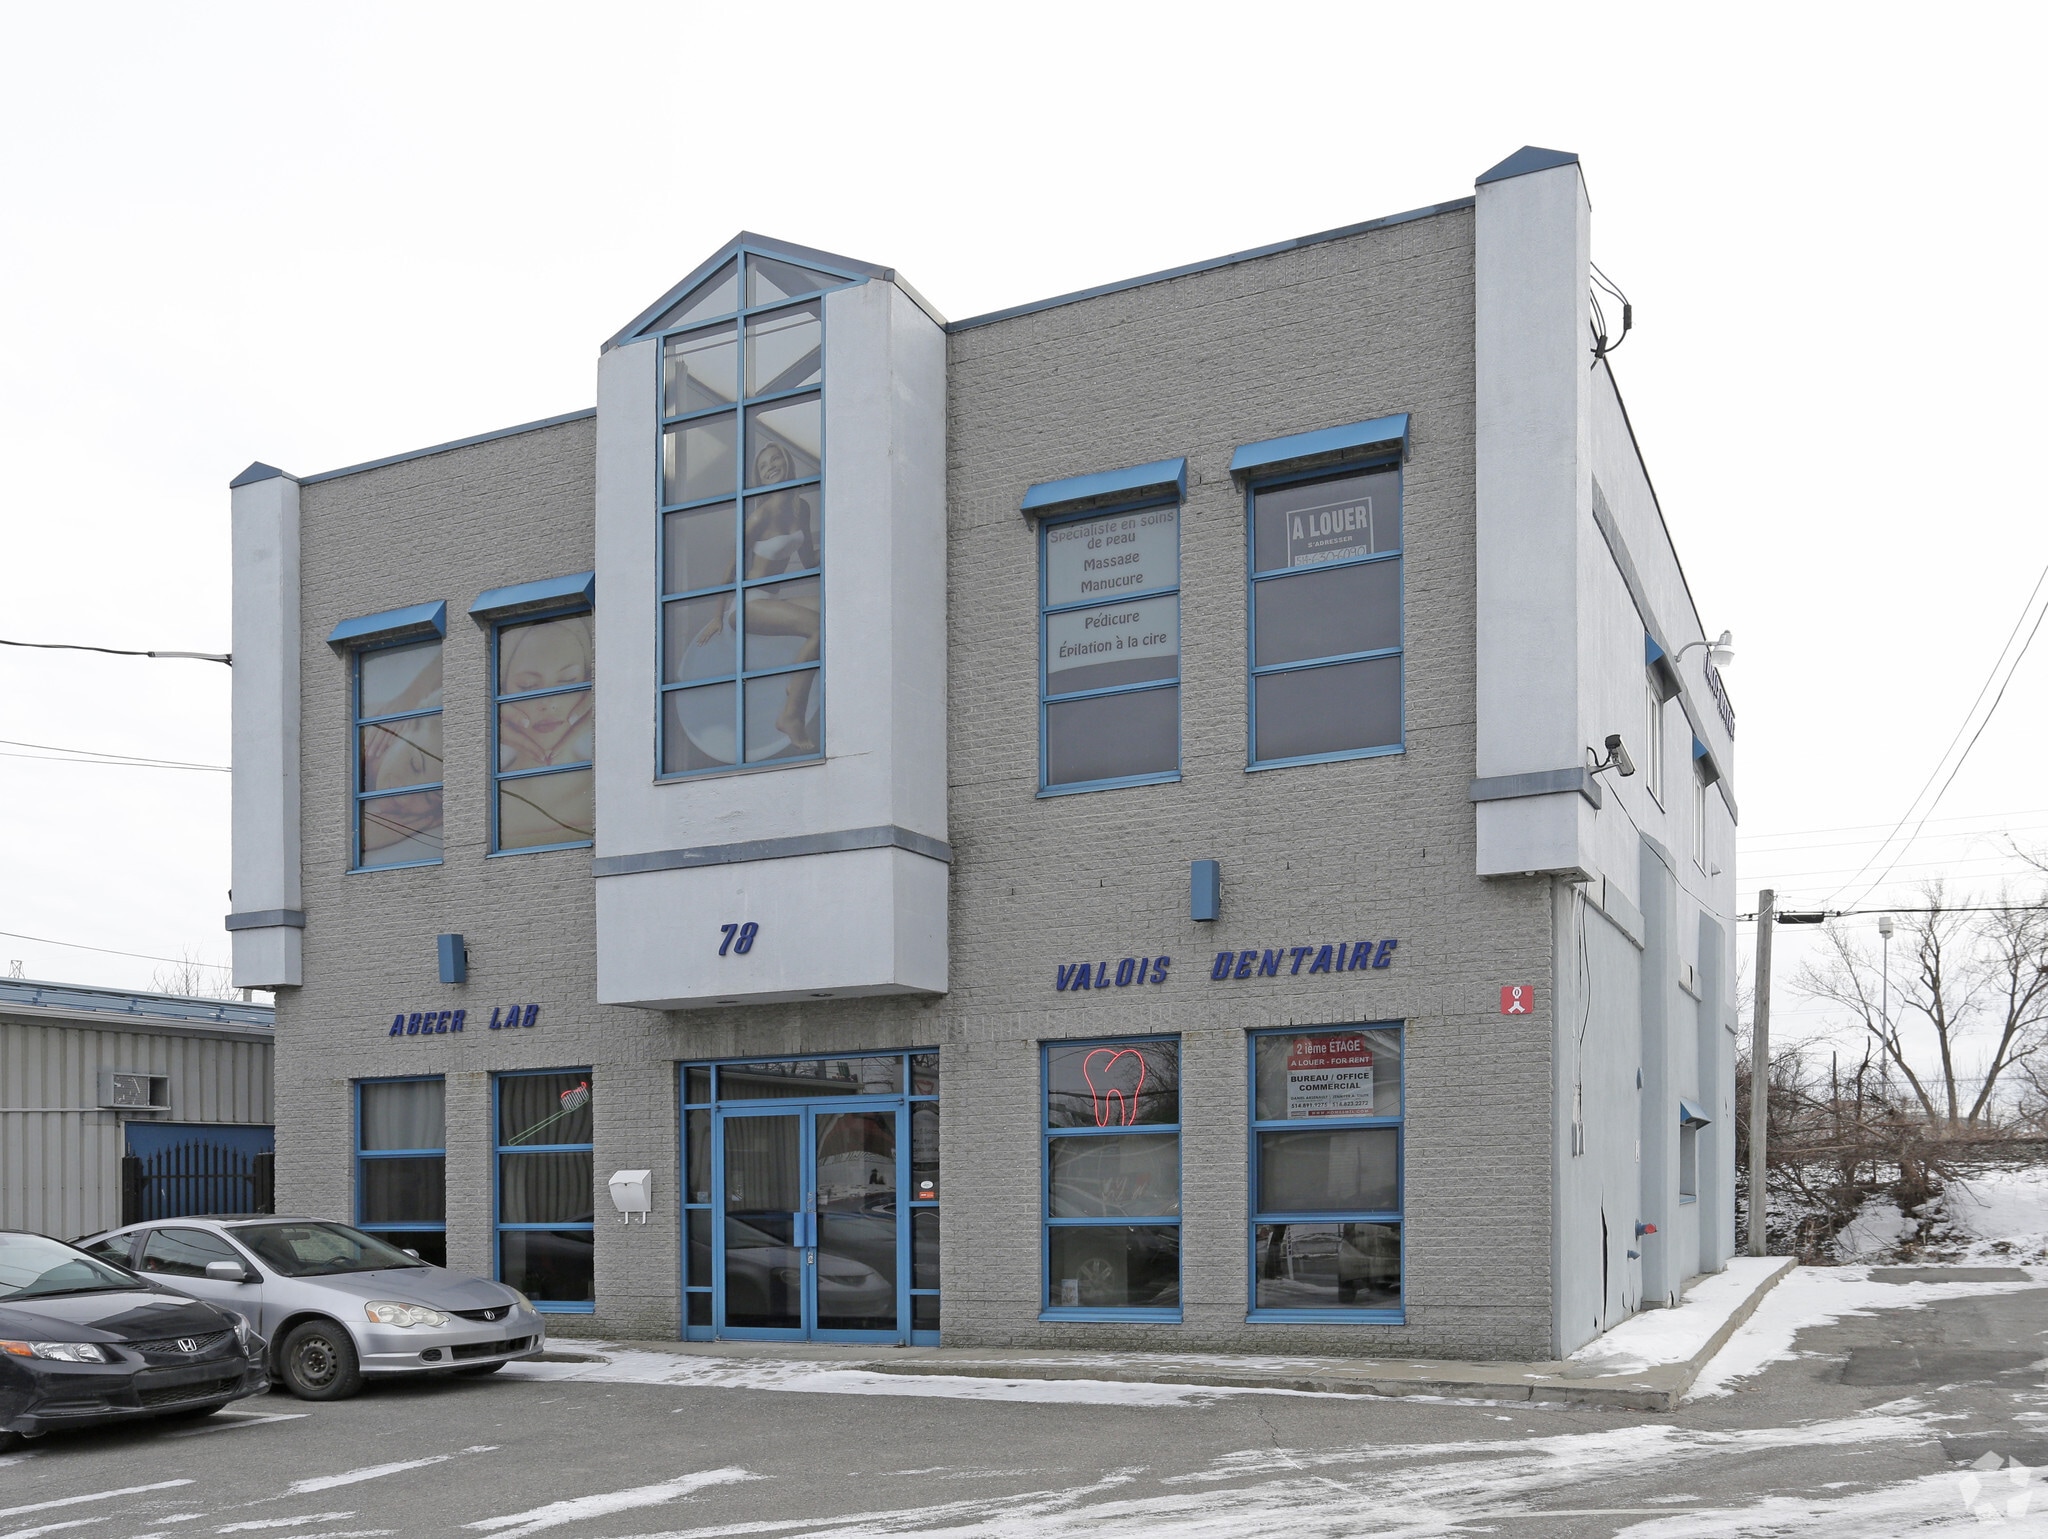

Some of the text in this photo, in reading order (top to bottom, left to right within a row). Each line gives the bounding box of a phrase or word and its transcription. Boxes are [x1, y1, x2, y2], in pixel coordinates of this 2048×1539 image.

[1050, 511, 1174, 543] Spécialiste en soins
[1292, 505, 1367, 540] A LOUER
[1087, 532, 1136, 549] de peau
[1308, 535, 1353, 548] S'ADRESSER
[1084, 552, 1140, 571] Massage
[1081, 573, 1144, 593] Manucure
[1085, 611, 1140, 629] Pédicure
[1059, 632, 1167, 658] Épilation à la cire
[719, 921, 759, 956] 78
[1056, 939, 1398, 991] VALOIS DENTAIRE
[389, 1004, 539, 1036] ABEER LAB
[1296, 1038, 1361, 1055] 2 ième ÉTAGE
[1298, 1058, 1325, 1066] LOUER
[1331, 1057, 1347, 1065] FOR
[1349, 1056, 1370, 1064] RENT
[1290, 1074, 1329, 1083] BUREAU
[1336, 1072, 1370, 1080] OFFICE
[1299, 1082, 1361, 1091] COMMERCIAL
